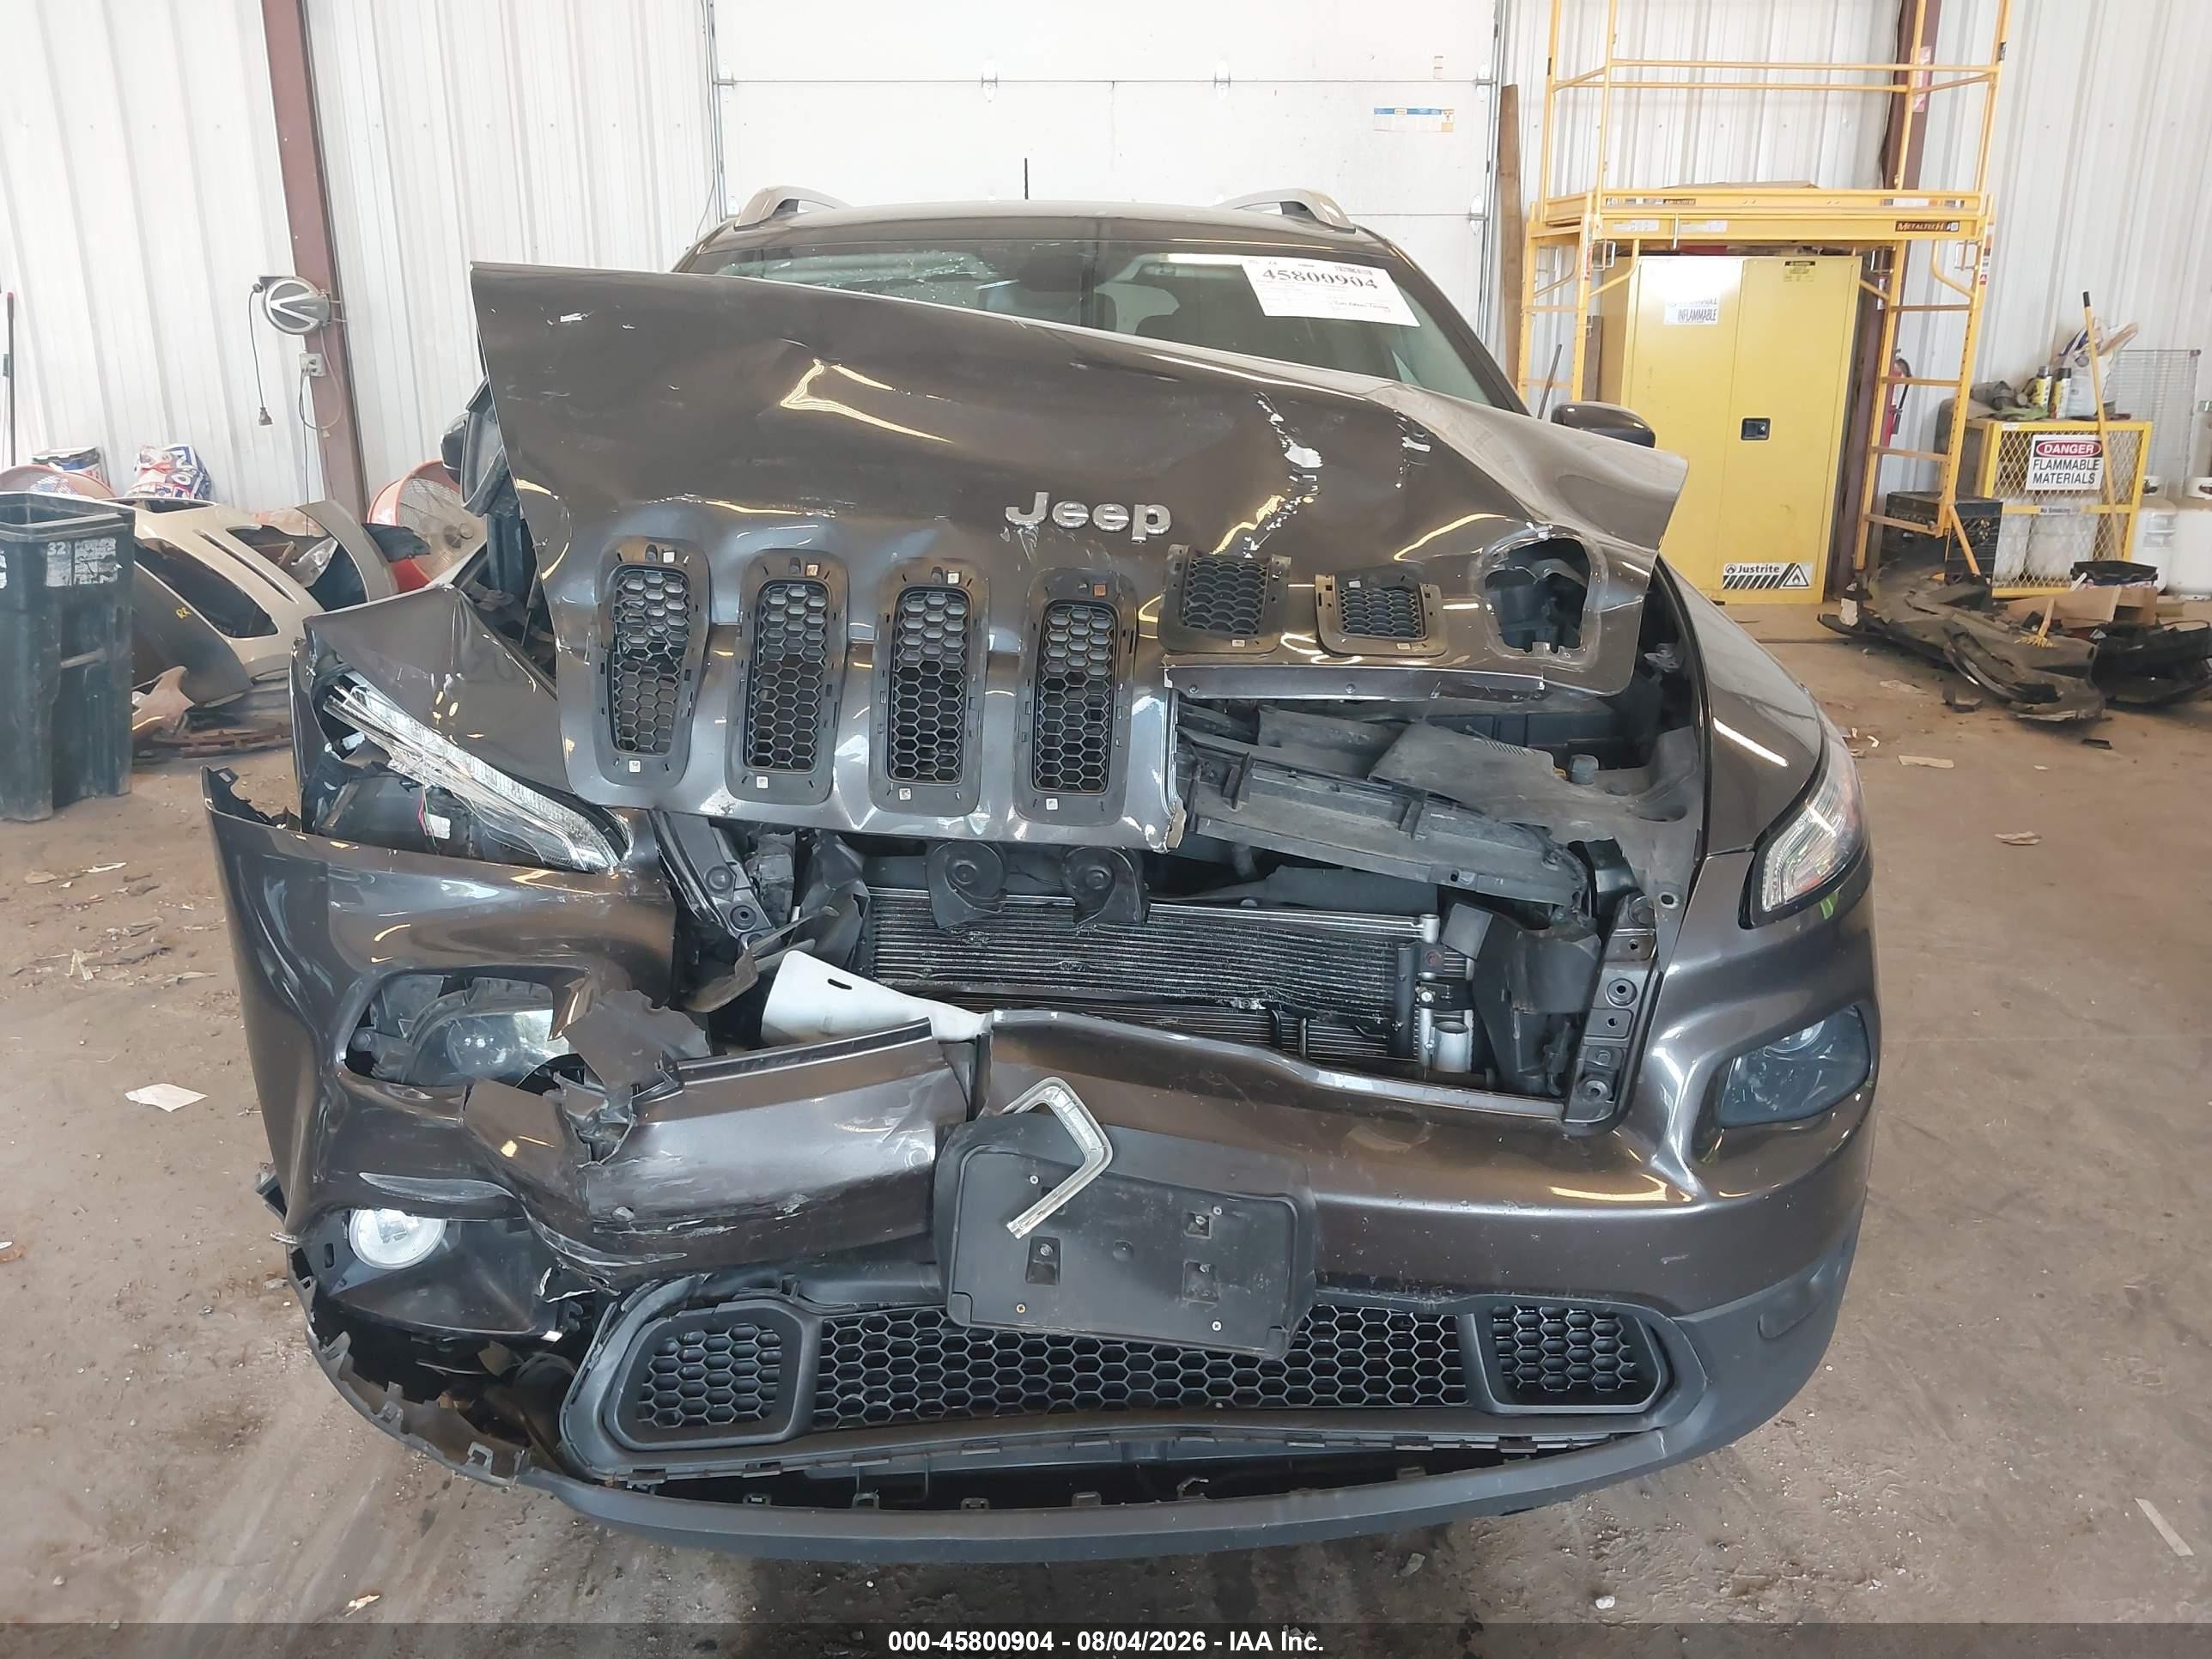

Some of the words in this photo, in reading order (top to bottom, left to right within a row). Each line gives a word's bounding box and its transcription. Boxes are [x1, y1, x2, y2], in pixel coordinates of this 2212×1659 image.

[1262, 269, 1378, 289] 45800904
[2044, 443, 2095, 454] DANGER
[2033, 459, 2100, 471] FLAMMABLE
[2033, 472, 2096, 484] MATERIALS
[1005, 491, 1173, 543] Jeep
[1737, 564, 1780, 574] Justrite
